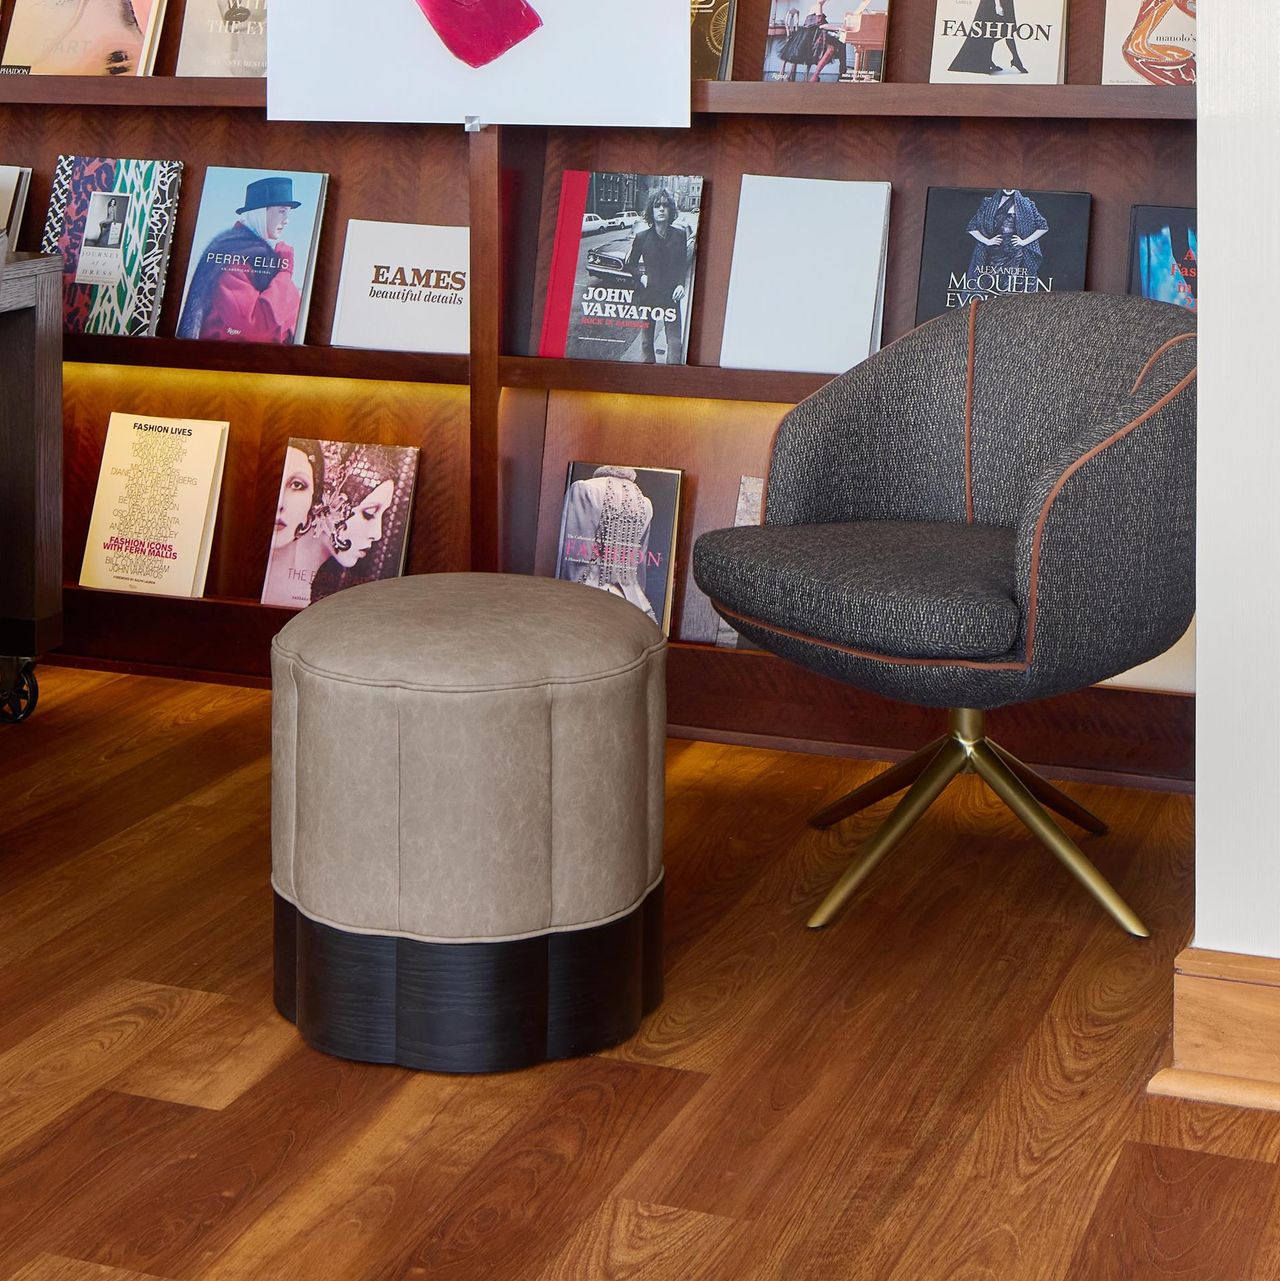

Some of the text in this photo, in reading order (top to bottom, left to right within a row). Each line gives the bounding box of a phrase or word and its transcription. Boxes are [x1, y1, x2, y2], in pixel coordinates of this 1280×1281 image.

[208, 20, 242, 34] THE
[941, 19, 1053, 42] FASHION
[0, 67, 29, 75] PHAIDON
[206, 252, 289, 269] PERRY ELLIS
[371, 264, 467, 292] EAMES
[973, 265, 1028, 276] ALEXANDER
[368, 286, 464, 306] beautiful details
[582, 286, 634, 303] JOHN
[581, 302, 677, 322] VARVATOS
[133, 422, 170, 434] FASHION
[170, 427, 193, 437] LIVES
[103, 542, 178, 560] WITH FERN MALLIS
[110, 536, 173, 552] FASHION ICONS
[288, 567, 307, 582] THE
